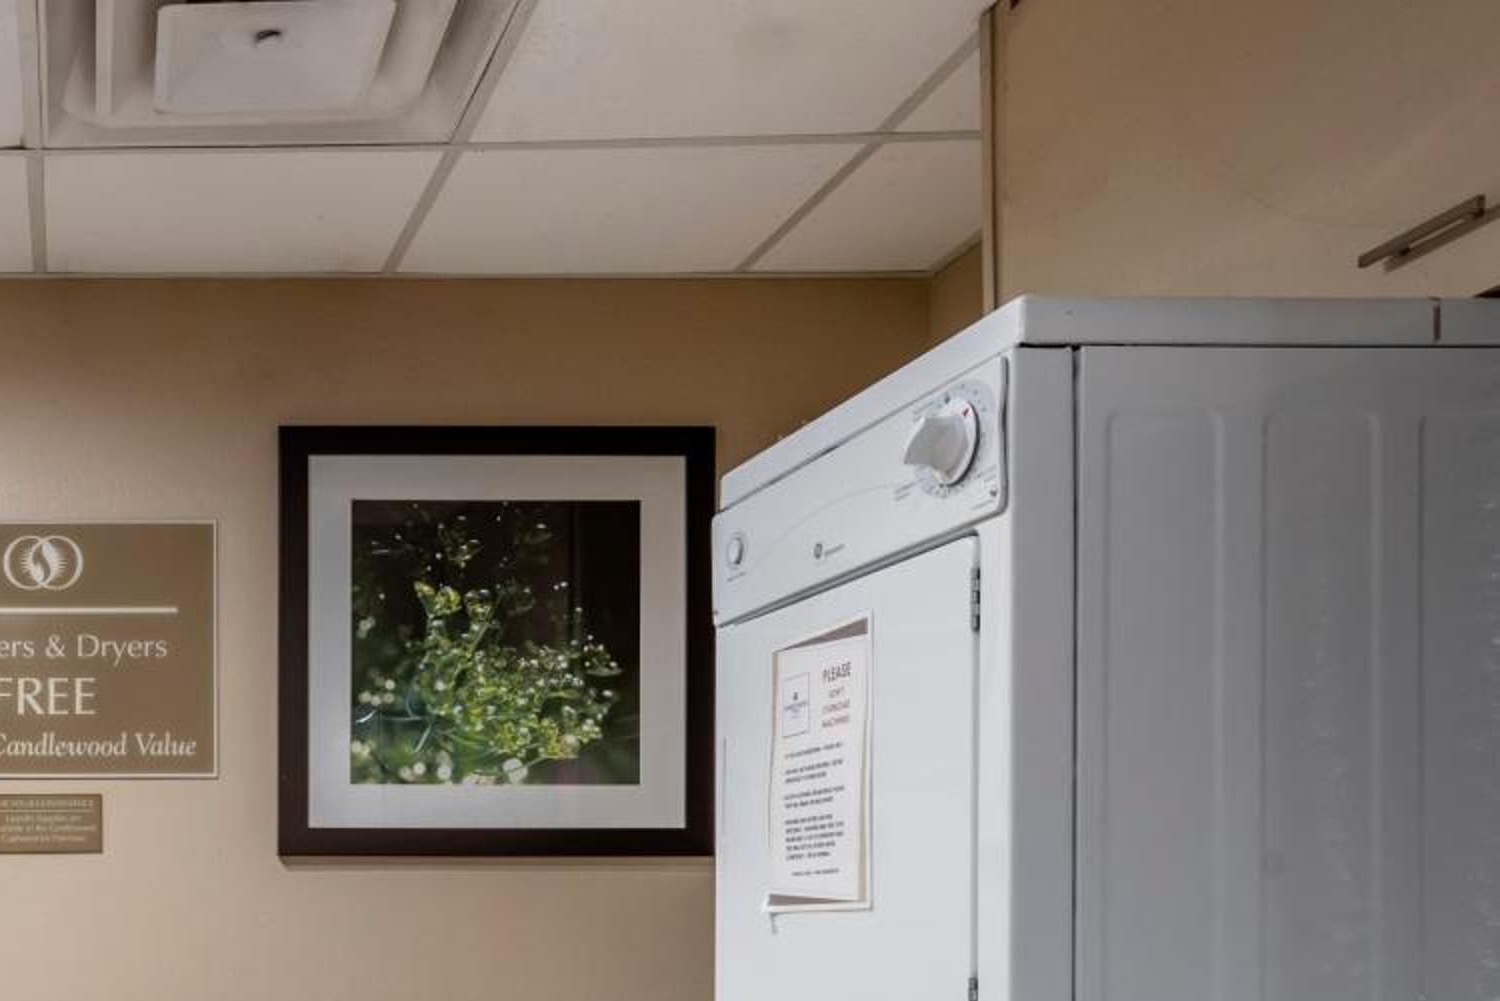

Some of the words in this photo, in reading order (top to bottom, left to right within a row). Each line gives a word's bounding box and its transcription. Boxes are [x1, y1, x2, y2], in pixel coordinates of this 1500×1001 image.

[45, 636, 66, 657] &
[77, 634, 168, 666] Dryers
[134, 732, 197, 756] Value
